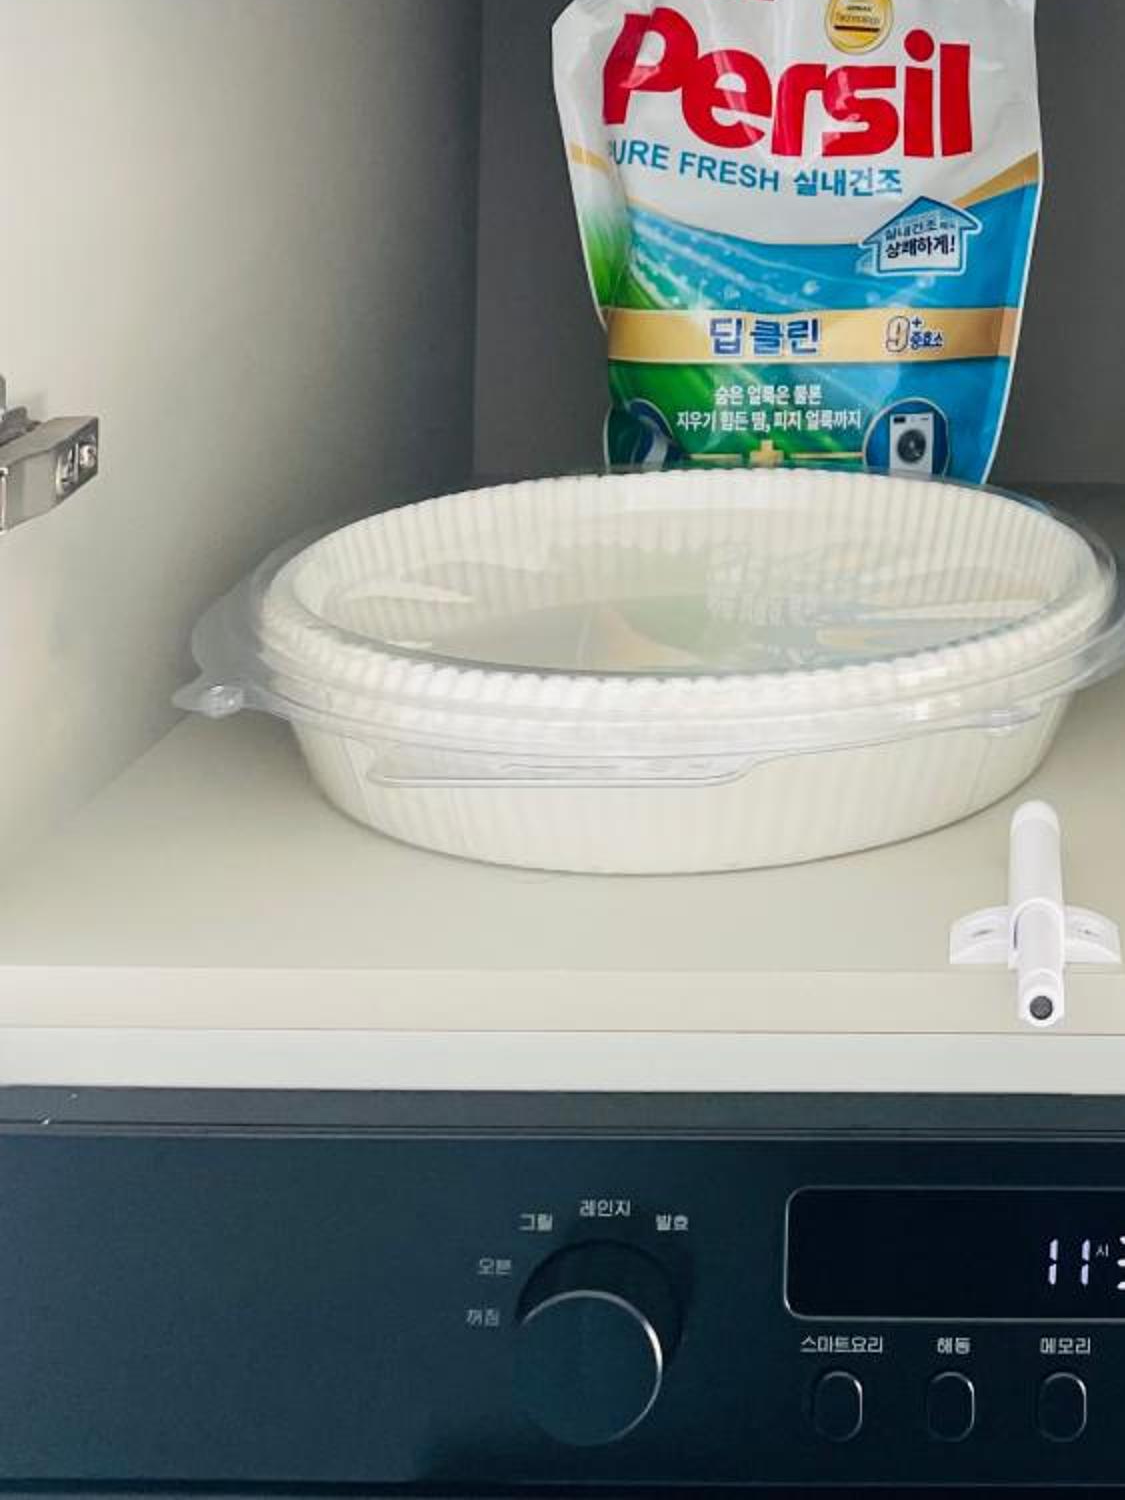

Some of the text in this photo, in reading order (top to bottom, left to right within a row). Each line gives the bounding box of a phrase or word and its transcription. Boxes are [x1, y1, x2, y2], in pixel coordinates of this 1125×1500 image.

[603, 6, 972, 158] Persil
[679, 151, 779, 192] FRESH
[793, 168, 903, 197] 실내건조
[885, 233, 955, 259] 상쾌하게!
[714, 385, 745, 405] 숨은
[747, 384, 791, 405] 얼룩은
[676, 410, 716, 432] 지우기
[720, 411, 749, 431] 힘든
[773, 410, 801, 431] 피지
[805, 409, 862, 431] 얼룩까지
[579, 1199, 632, 1217] 레인지
[519, 1213, 554, 1232] 그릴
[655, 1214, 690, 1232] 발효
[477, 1258, 513, 1276] 오븐
[466, 1308, 500, 1327] 꺼짐
[800, 1335, 884, 1355] 스마트요리
[936, 1337, 971, 1355] 해동
[1039, 1337, 1092, 1356] 메모리
